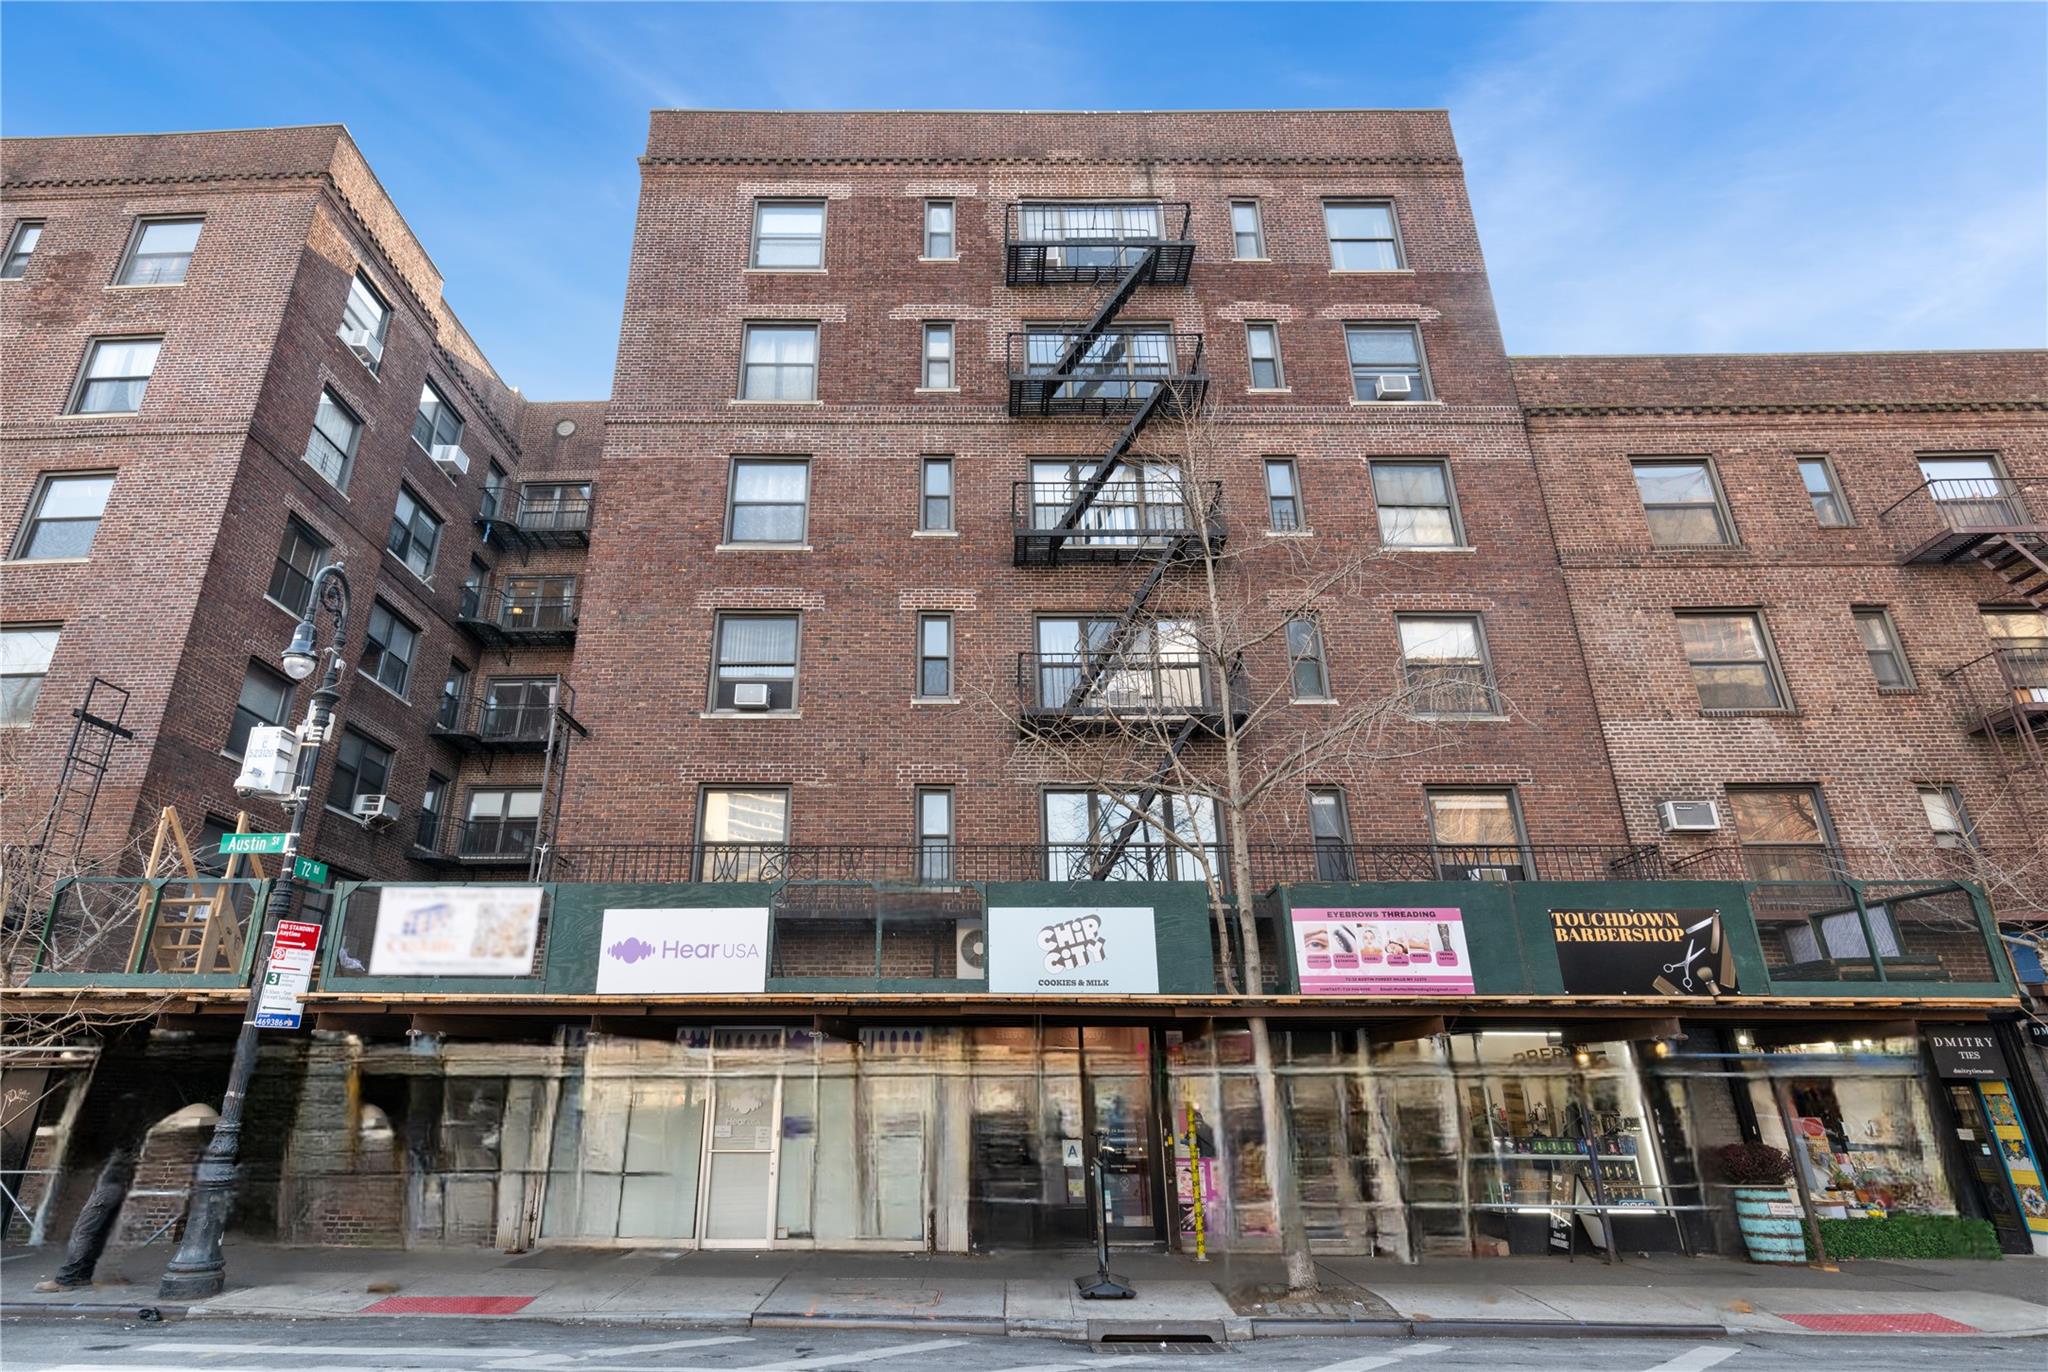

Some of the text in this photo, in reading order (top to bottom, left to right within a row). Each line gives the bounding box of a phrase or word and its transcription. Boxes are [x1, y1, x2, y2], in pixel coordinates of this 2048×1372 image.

[227, 835, 280, 851] Austin St
[301, 861, 312, 878] 72
[1551, 912, 1680, 927] TOUCHDOWN
[279, 930, 301, 938] Anytime
[289, 925, 315, 933] STANDING
[1554, 927, 1685, 942] BARBERSHOP
[269, 973, 278, 984] 3
[1933, 1036, 1993, 1048] DMITRY
[1958, 1051, 1981, 1059] TIES
[1067, 1144, 1078, 1158] A
